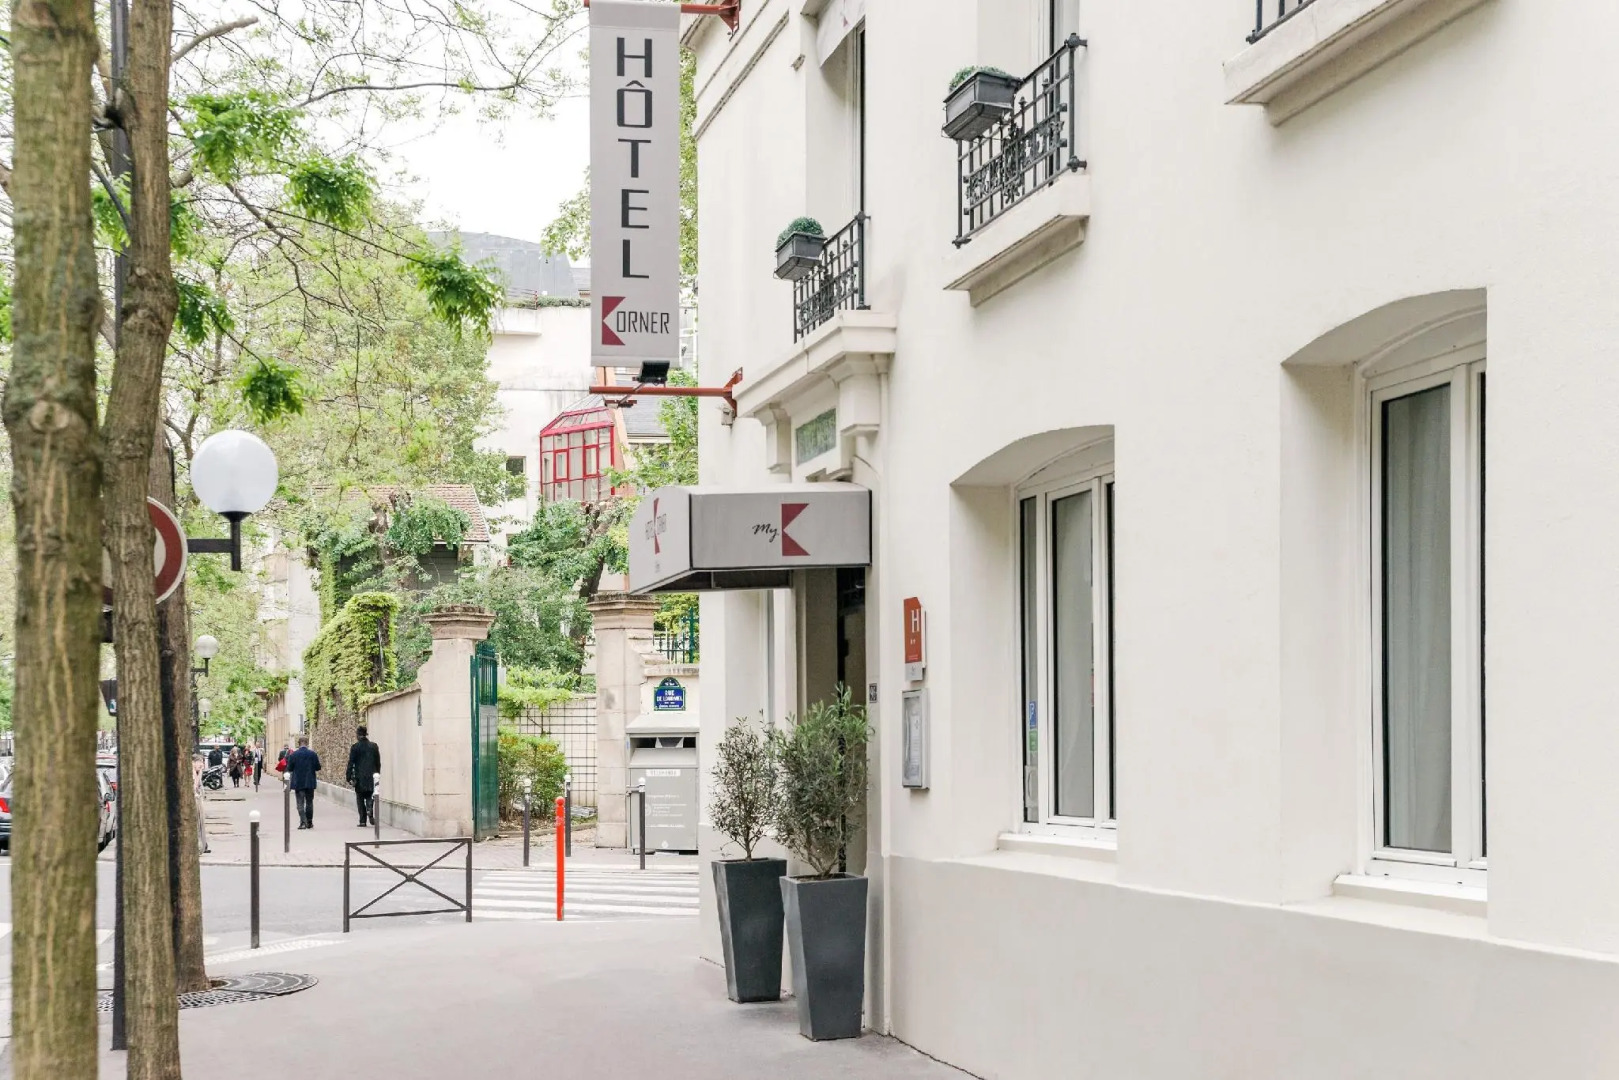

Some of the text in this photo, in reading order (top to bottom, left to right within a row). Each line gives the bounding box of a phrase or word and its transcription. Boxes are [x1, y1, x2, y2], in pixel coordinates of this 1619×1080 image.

[616, 37, 653, 279] HÔTEL
[602, 296, 670, 346] KORNER
[752, 523, 779, 543] My
[911, 608, 920, 633] H
